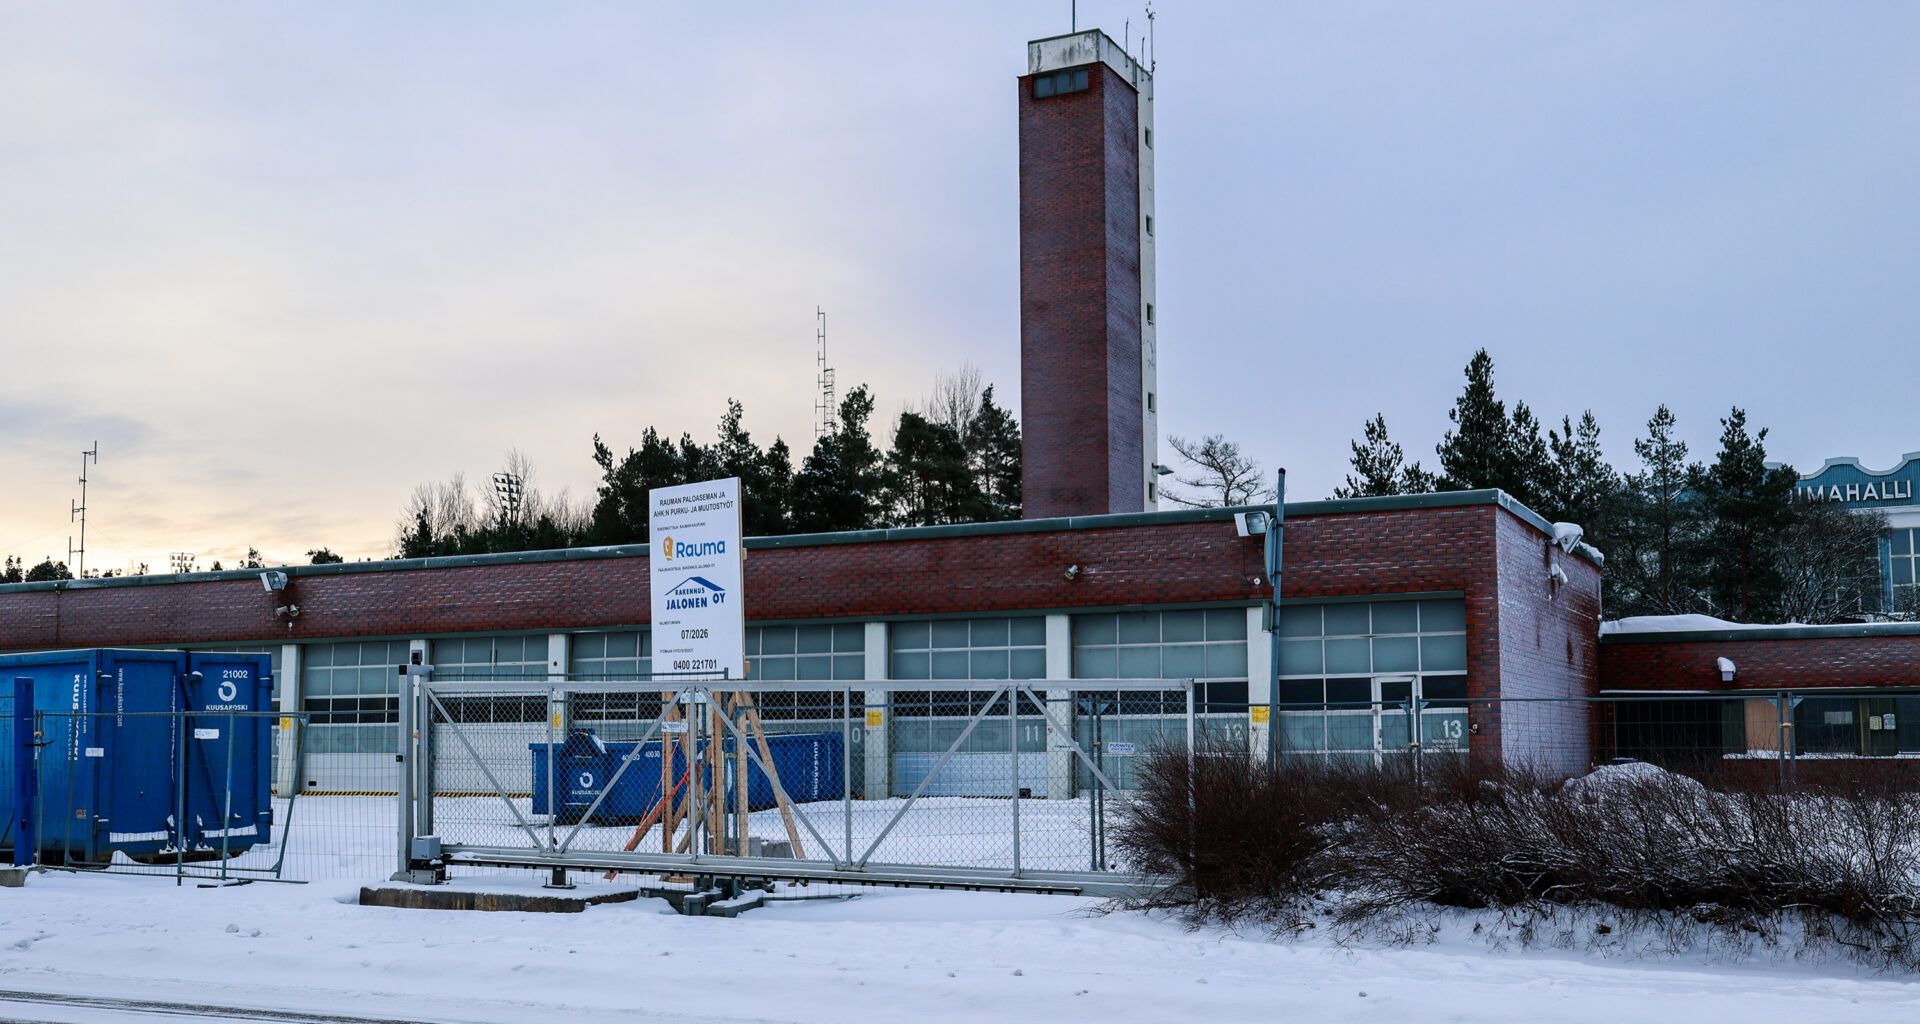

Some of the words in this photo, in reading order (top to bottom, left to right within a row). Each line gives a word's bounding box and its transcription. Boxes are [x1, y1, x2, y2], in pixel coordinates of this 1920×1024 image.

[659, 498, 682, 506] RAUMAN
[682, 492, 718, 503] PALOASEMAN
[718, 491, 726, 499] JA
[1788, 480, 1911, 504] IMAHALLI
[653, 509, 670, 518] AHK:N
[670, 506, 690, 515] PURKU-
[690, 505, 698, 513] JA
[698, 500, 734, 512] MUUTOSTYÖT
[676, 540, 726, 558] Rauma
[675, 587, 705, 595] RAKENNUS
[666, 597, 708, 610] JALONEN
[712, 593, 726, 604] OY
[681, 628, 709, 639] 07/2026
[673, 660, 691, 670] 0400
[691, 659, 717, 670] 221701
[222, 670, 248, 679] 21002
[1024, 725, 1039, 742] 11
[1225, 724, 1243, 742] 12
[1442, 720, 1462, 738] 13
